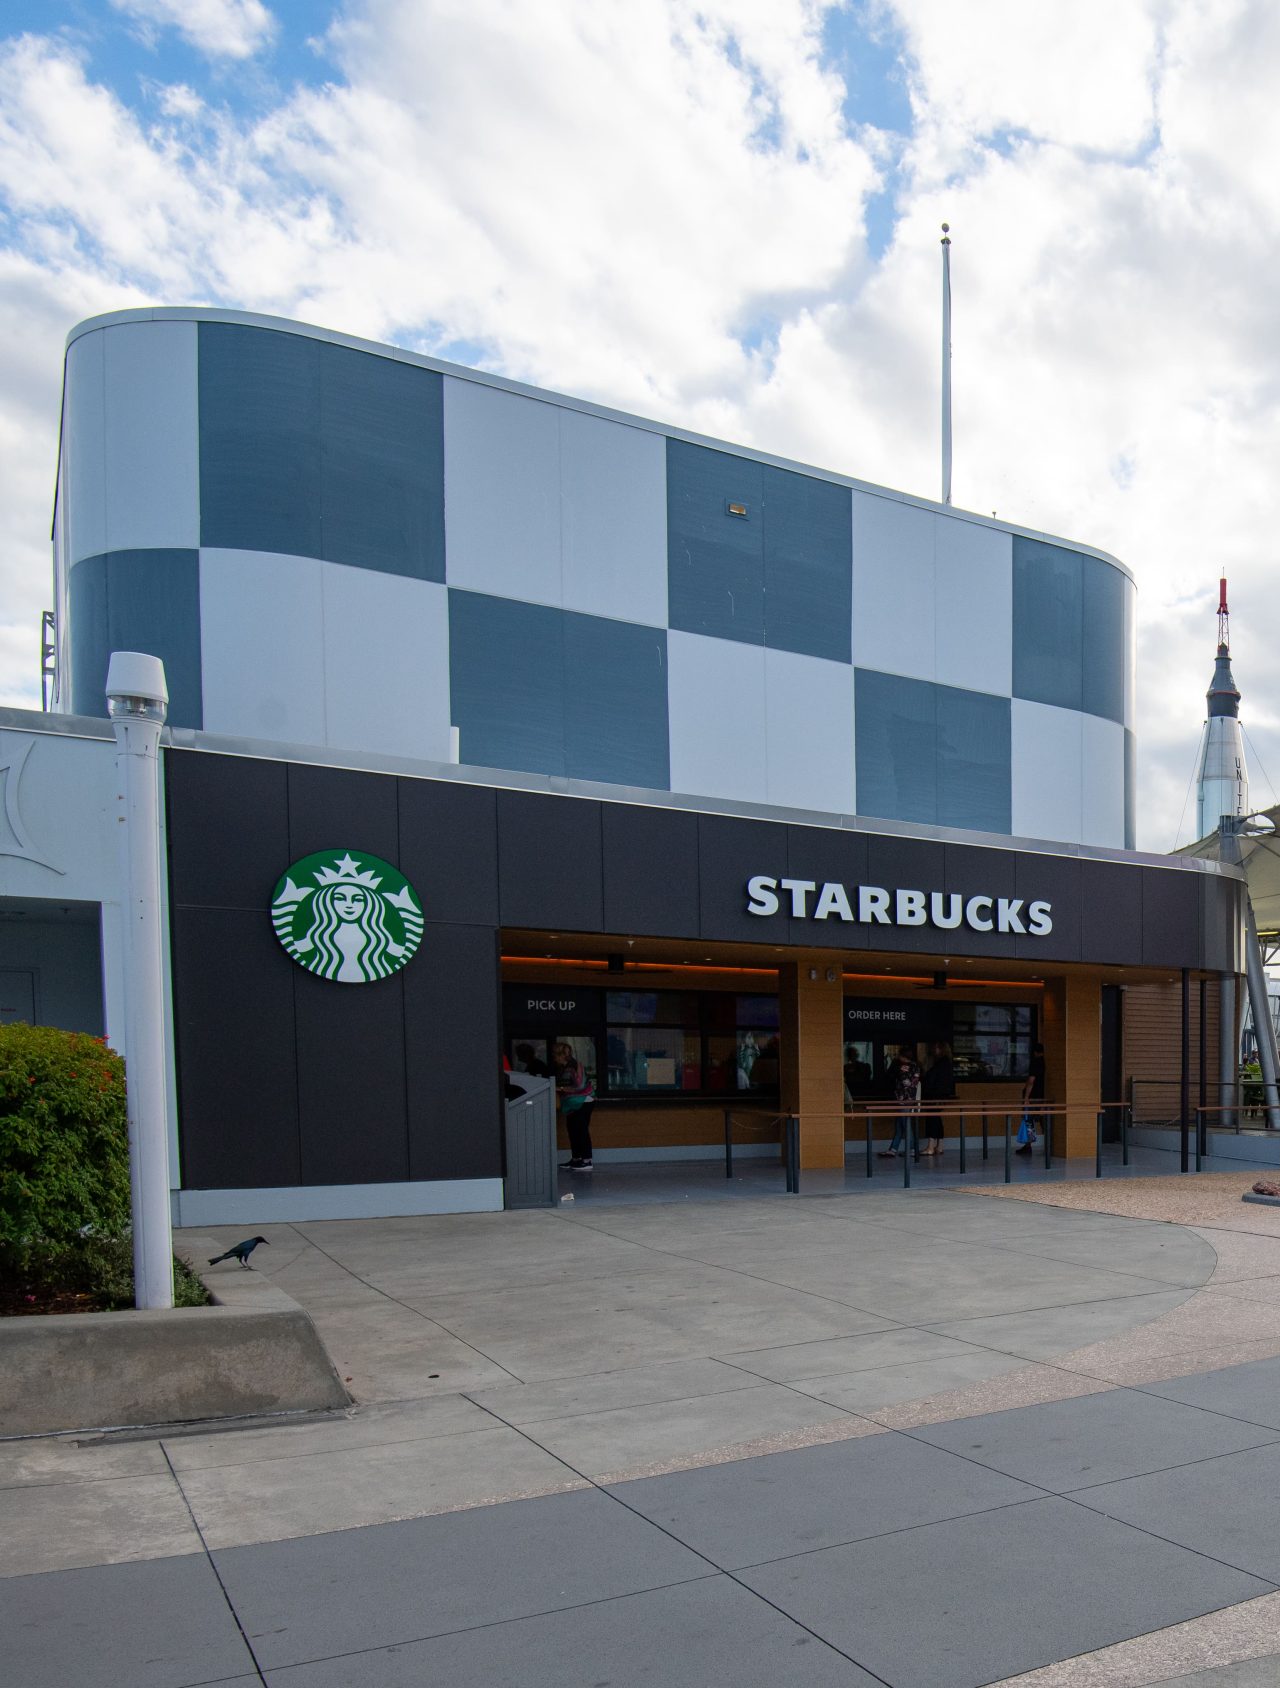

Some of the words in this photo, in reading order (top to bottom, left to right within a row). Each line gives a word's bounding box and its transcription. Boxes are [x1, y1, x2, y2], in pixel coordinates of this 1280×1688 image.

[747, 875, 1053, 936] STARBUCKS
[527, 999, 556, 1011] PICK
[559, 1000, 576, 1011] UP
[848, 1010, 881, 1020] ORDER
[882, 1011, 906, 1021] HERE
